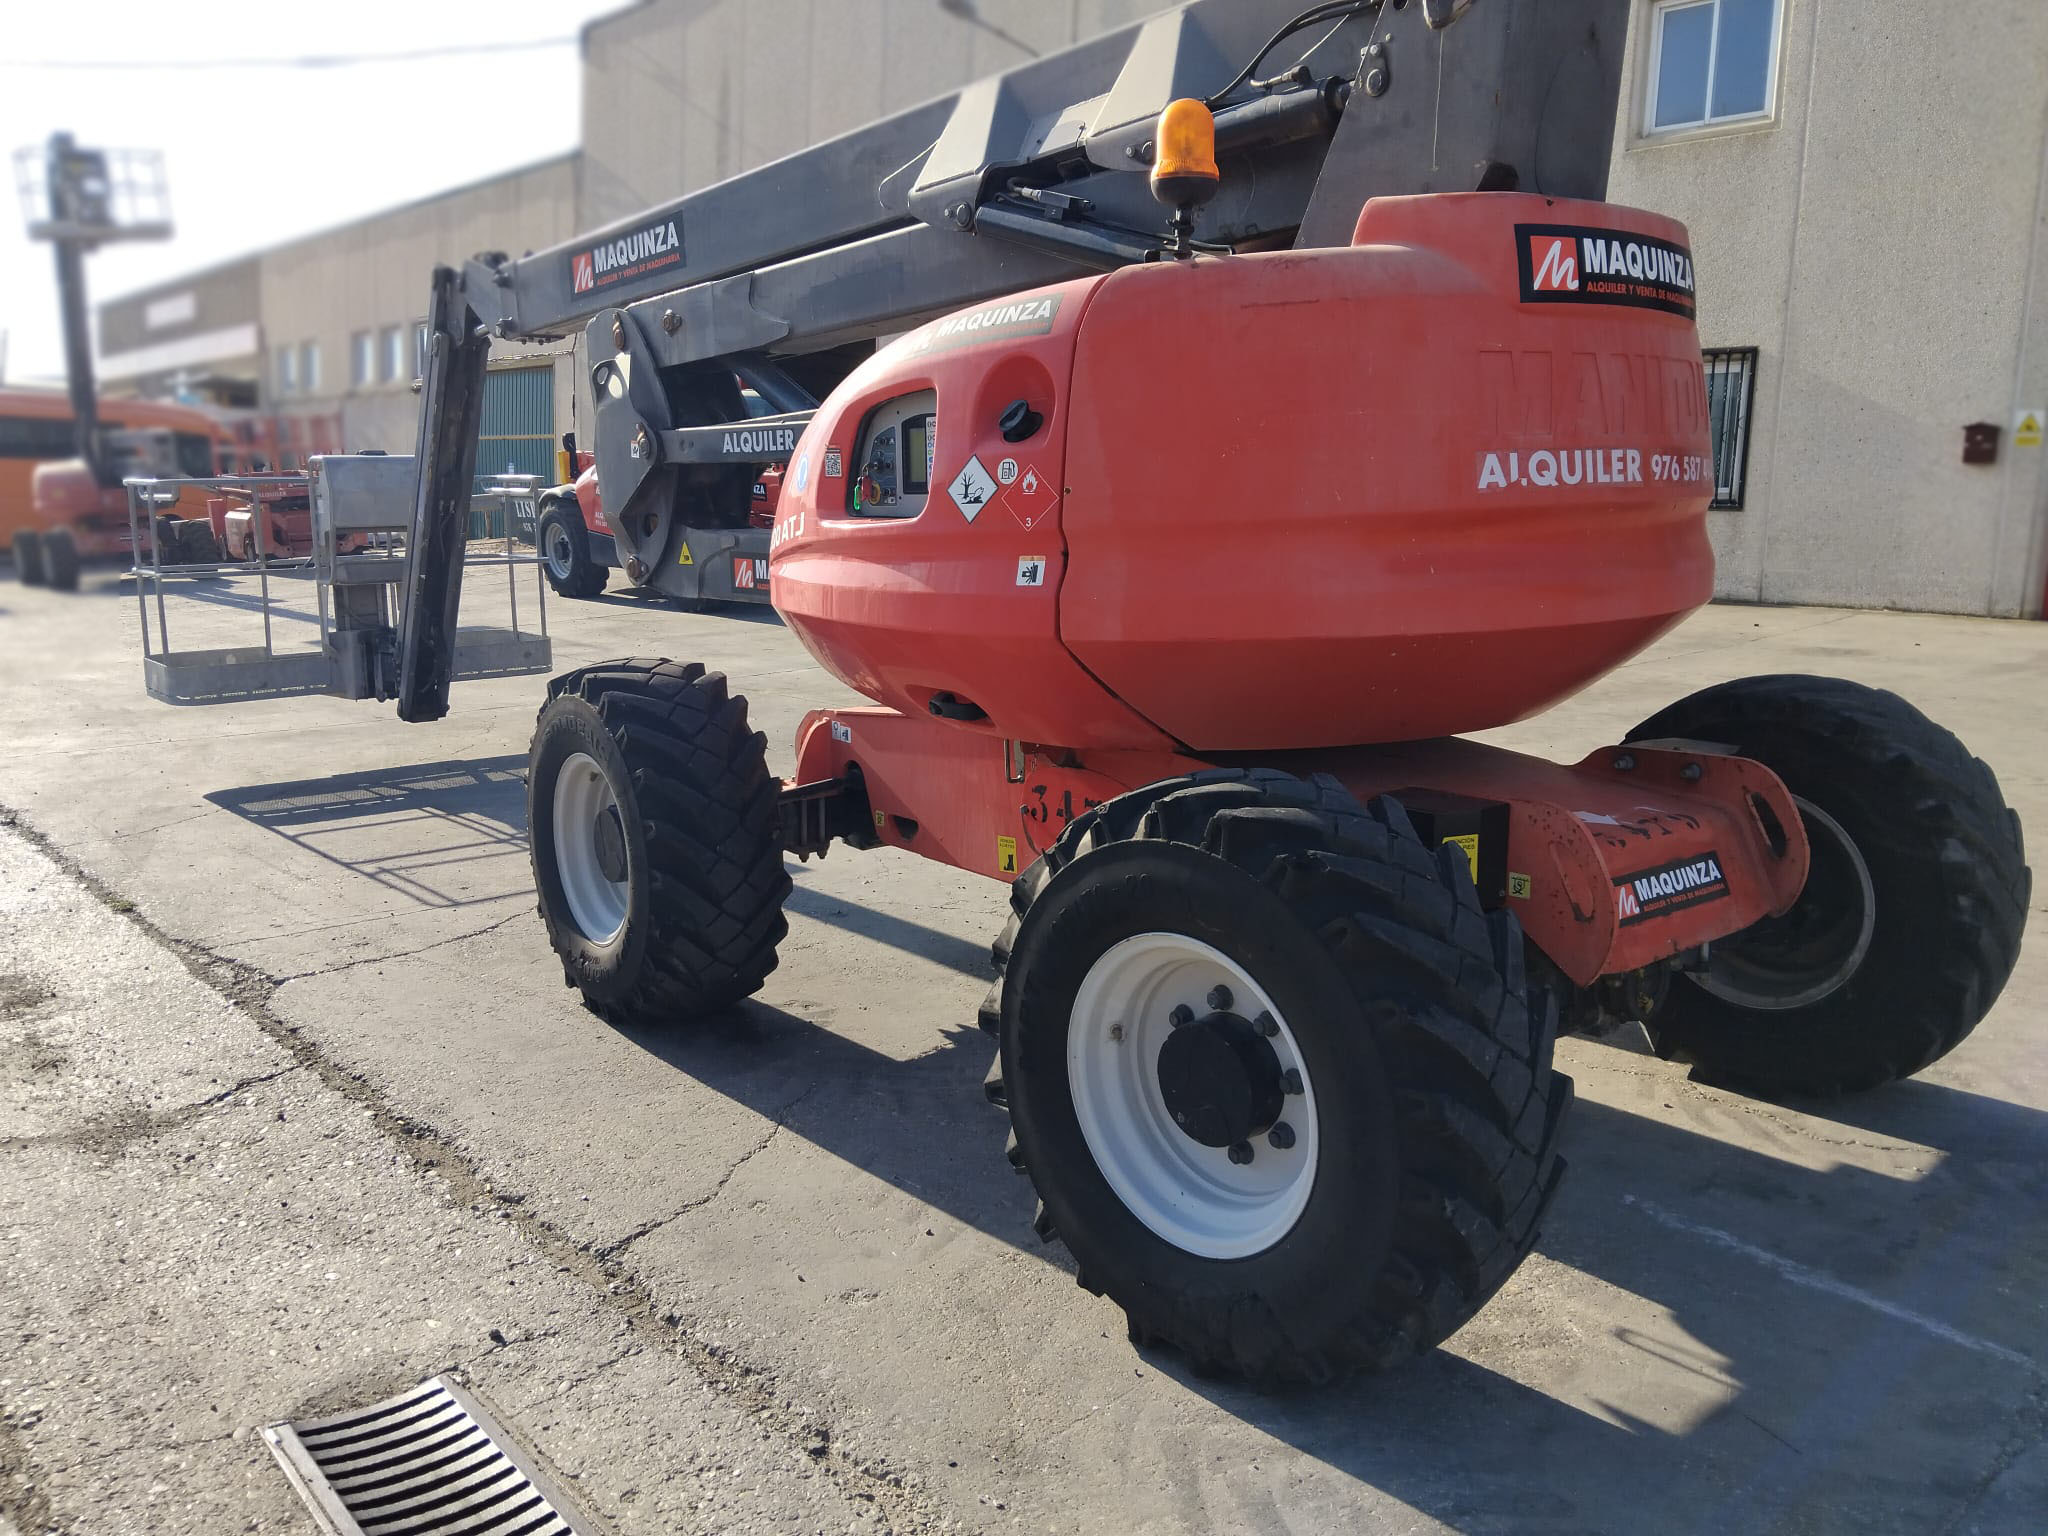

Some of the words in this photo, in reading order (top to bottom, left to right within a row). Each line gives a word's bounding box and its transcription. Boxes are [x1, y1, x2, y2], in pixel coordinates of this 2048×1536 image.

[594, 221, 680, 274] MAQUINZA
[1583, 237, 1694, 292] MAQUINZA
[1587, 281, 1627, 295] ALQUILER
[1627, 283, 1634, 295] Y
[1636, 285, 1657, 298] VENTA
[935, 299, 1052, 337] MAQUINZA
[723, 429, 795, 453] ALQUILER
[1652, 454, 1680, 481] 976
[1683, 455, 1701, 481] 587
[1025, 517, 1032, 527] 3
[1634, 859, 1722, 902] MAQUINZA
